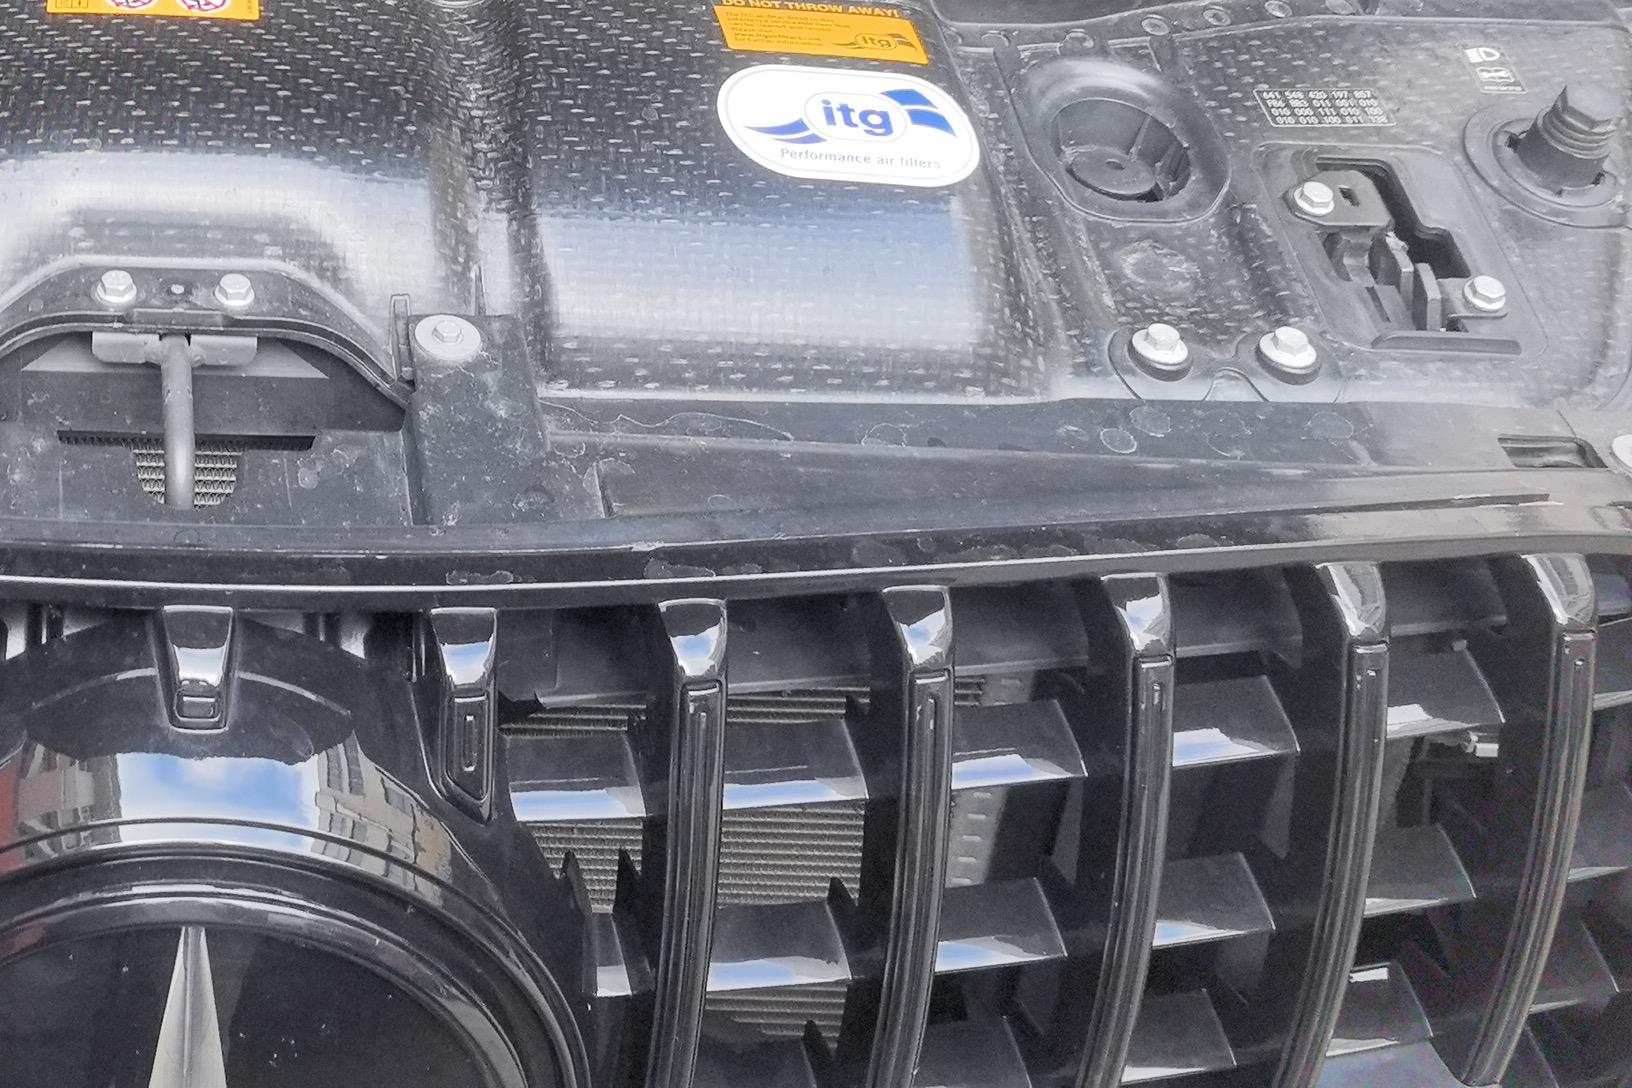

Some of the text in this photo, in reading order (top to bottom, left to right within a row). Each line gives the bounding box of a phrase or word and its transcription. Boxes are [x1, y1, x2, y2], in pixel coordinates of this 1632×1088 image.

[748, 0, 781, 9] NOT
[784, 1, 843, 13] THROW
[848, 5, 900, 18] AWAY!
[821, 99, 893, 137] itg
[781, 148, 871, 164] Performance
[877, 156, 894, 166] air
